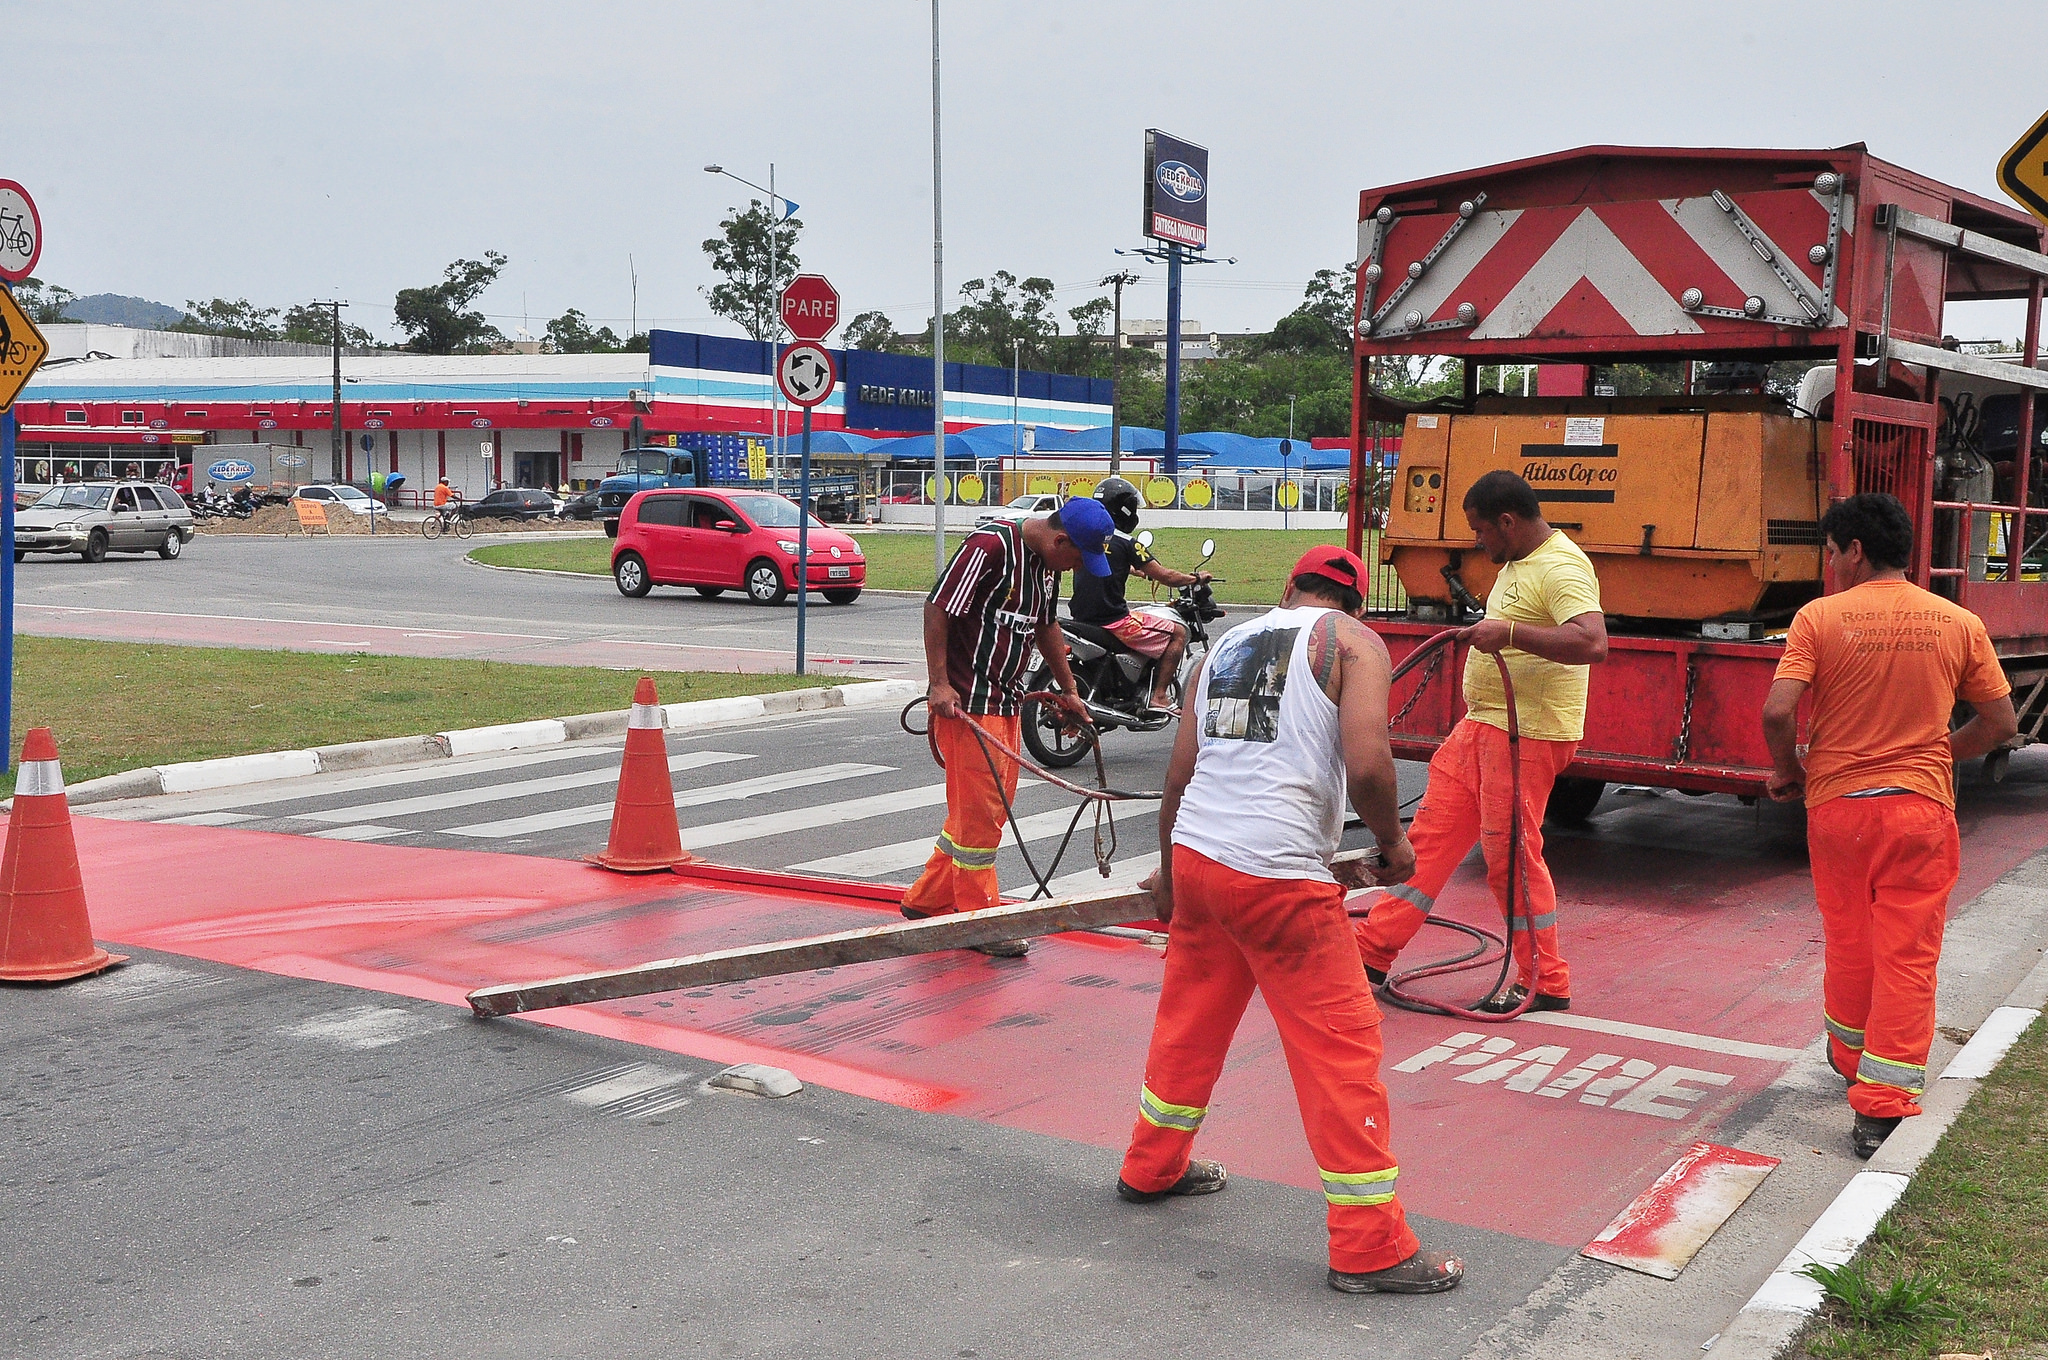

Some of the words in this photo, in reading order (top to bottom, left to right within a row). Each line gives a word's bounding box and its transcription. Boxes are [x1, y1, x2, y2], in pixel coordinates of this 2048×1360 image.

[1155, 216, 1177, 235] ENTREGA
[785, 298, 834, 318] PARE
[860, 384, 895, 404] REDE
[899, 388, 934, 407] KRILL
[961, 475, 980, 484] OFERTA
[1522, 462, 1567, 481] Atlas
[1072, 477, 1094, 486] OFERTA
[1187, 479, 1208, 488] OFERTA
[1841, 611, 1887, 622] Road
[1892, 610, 1951, 623] Traffic
[1854, 625, 1942, 637] Sinaização
[1390, 1031, 1736, 1120] PARE
